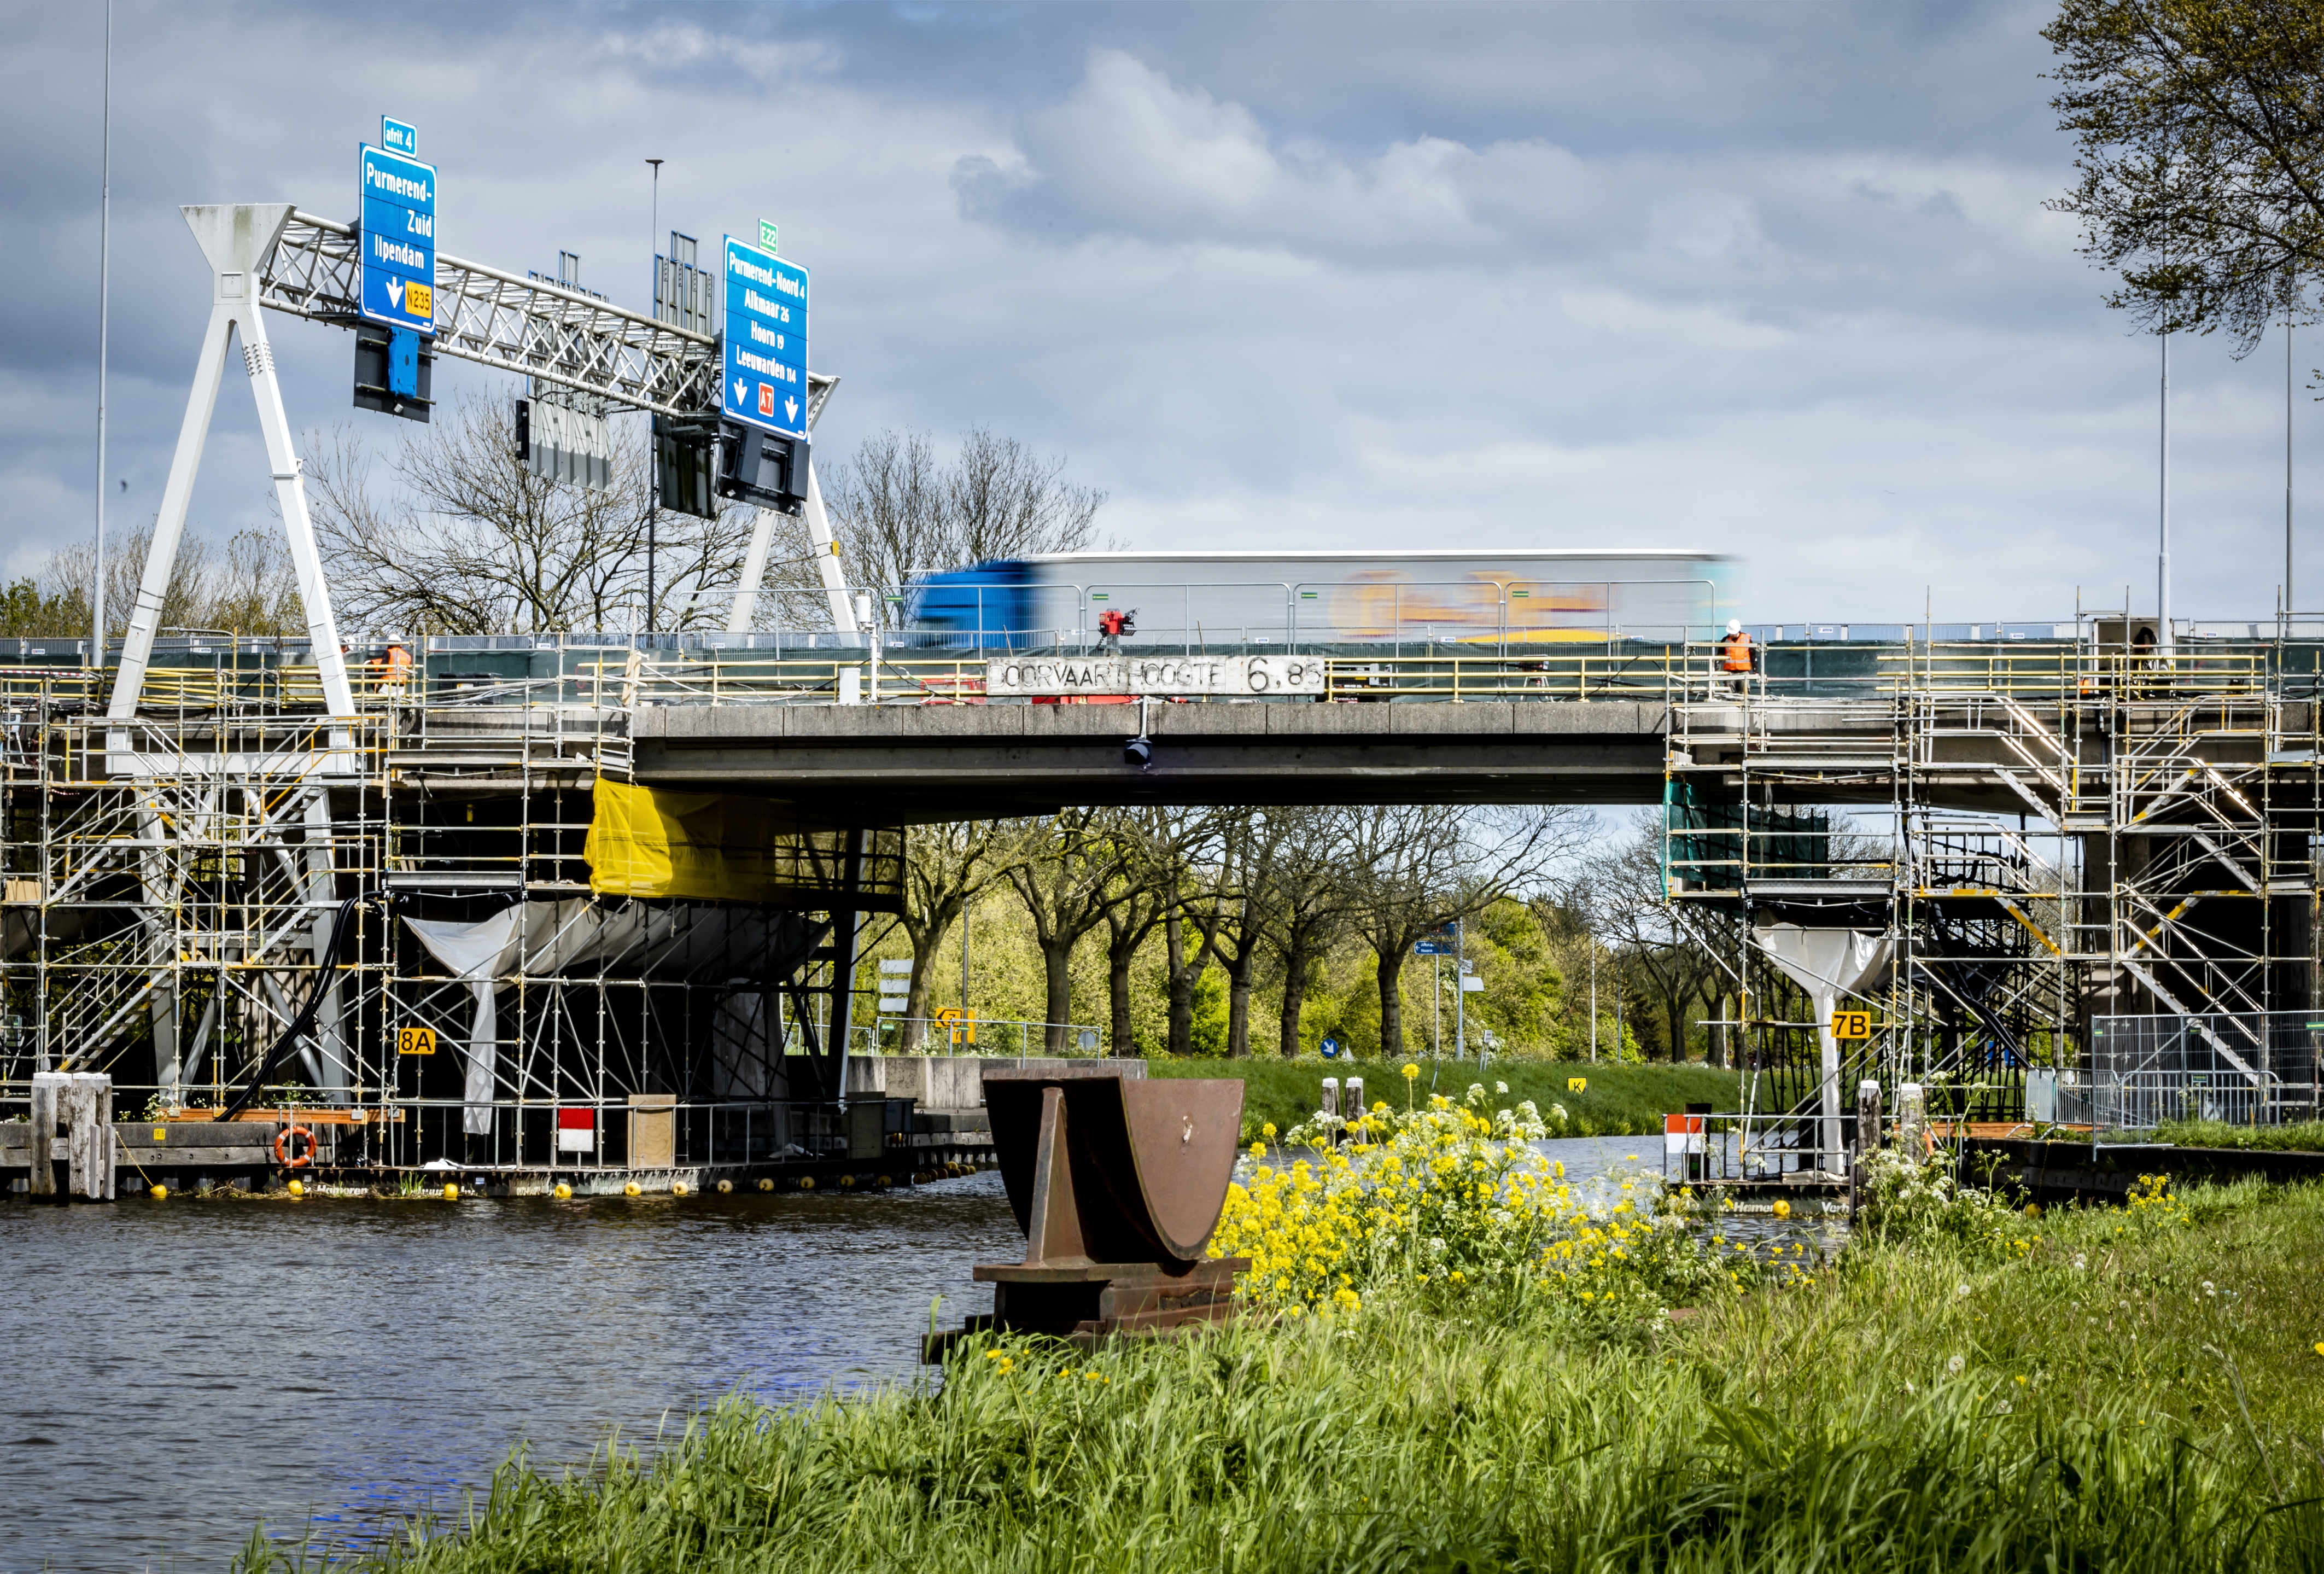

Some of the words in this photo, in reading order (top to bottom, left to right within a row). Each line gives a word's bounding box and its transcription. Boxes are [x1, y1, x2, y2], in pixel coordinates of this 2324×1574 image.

[386, 127, 403, 145] afrit
[405, 132, 412, 150] 4
[367, 162, 431, 201] Purmerend-
[407, 210, 431, 237] Zuid
[375, 234, 424, 269] Ilpendam
[761, 229, 776, 247] E22
[729, 252, 798, 297] Purmerend-Noord
[800, 285, 804, 300] 4
[407, 290, 430, 311] N235
[745, 289, 779, 319] Alkmaar
[781, 306, 789, 323] 26
[751, 320, 775, 347] Hoorn
[777, 334, 784, 349] 19
[737, 345, 784, 380] Leeuwarden
[787, 368, 796, 384] 114
[761, 391, 772, 409] A7
[1248, 657, 1321, 692] 6,85
[1834, 1015, 1866, 1035] 7B
[401, 1031, 431, 1051] 8A
[1574, 1082, 1581, 1093] K
